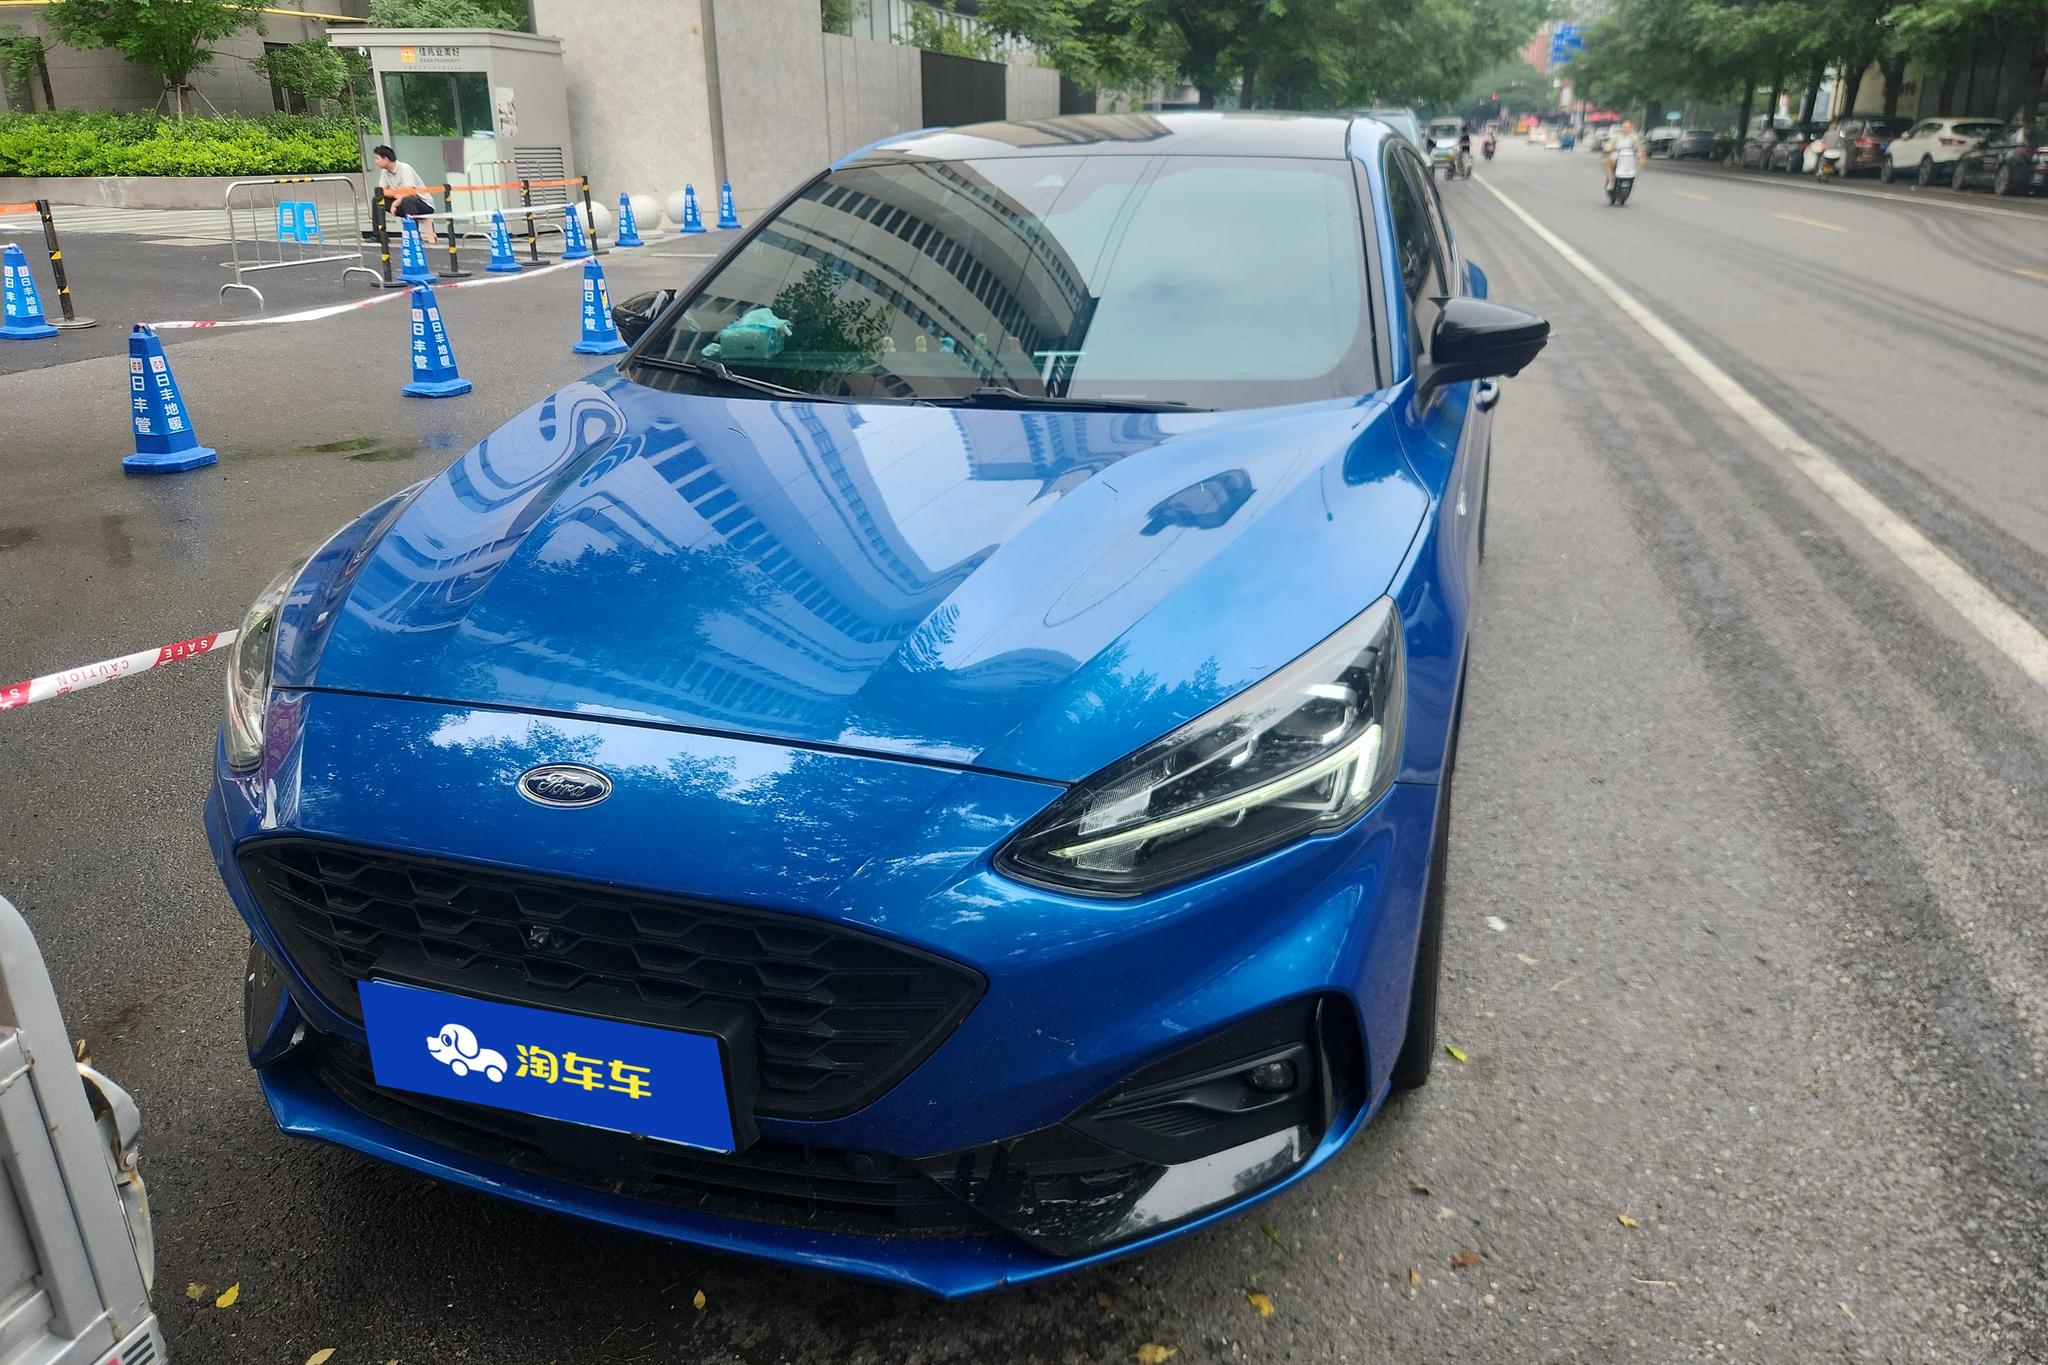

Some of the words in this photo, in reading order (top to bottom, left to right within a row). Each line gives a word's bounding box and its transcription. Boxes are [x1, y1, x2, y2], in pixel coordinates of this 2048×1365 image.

[5, 277, 17, 316] 日丰管
[21, 276, 40, 316] 日丰地暖
[584, 290, 596, 331] 日丰管
[412, 322, 428, 369] 日丰管
[431, 321, 451, 368] 日丰地暖
[131, 375, 151, 433] 日丰管
[155, 373, 184, 431] 日丰地暖
[164, 639, 208, 659] SAFE
[56, 659, 130, 687] CAUTION
[537, 773, 586, 798] Ford
